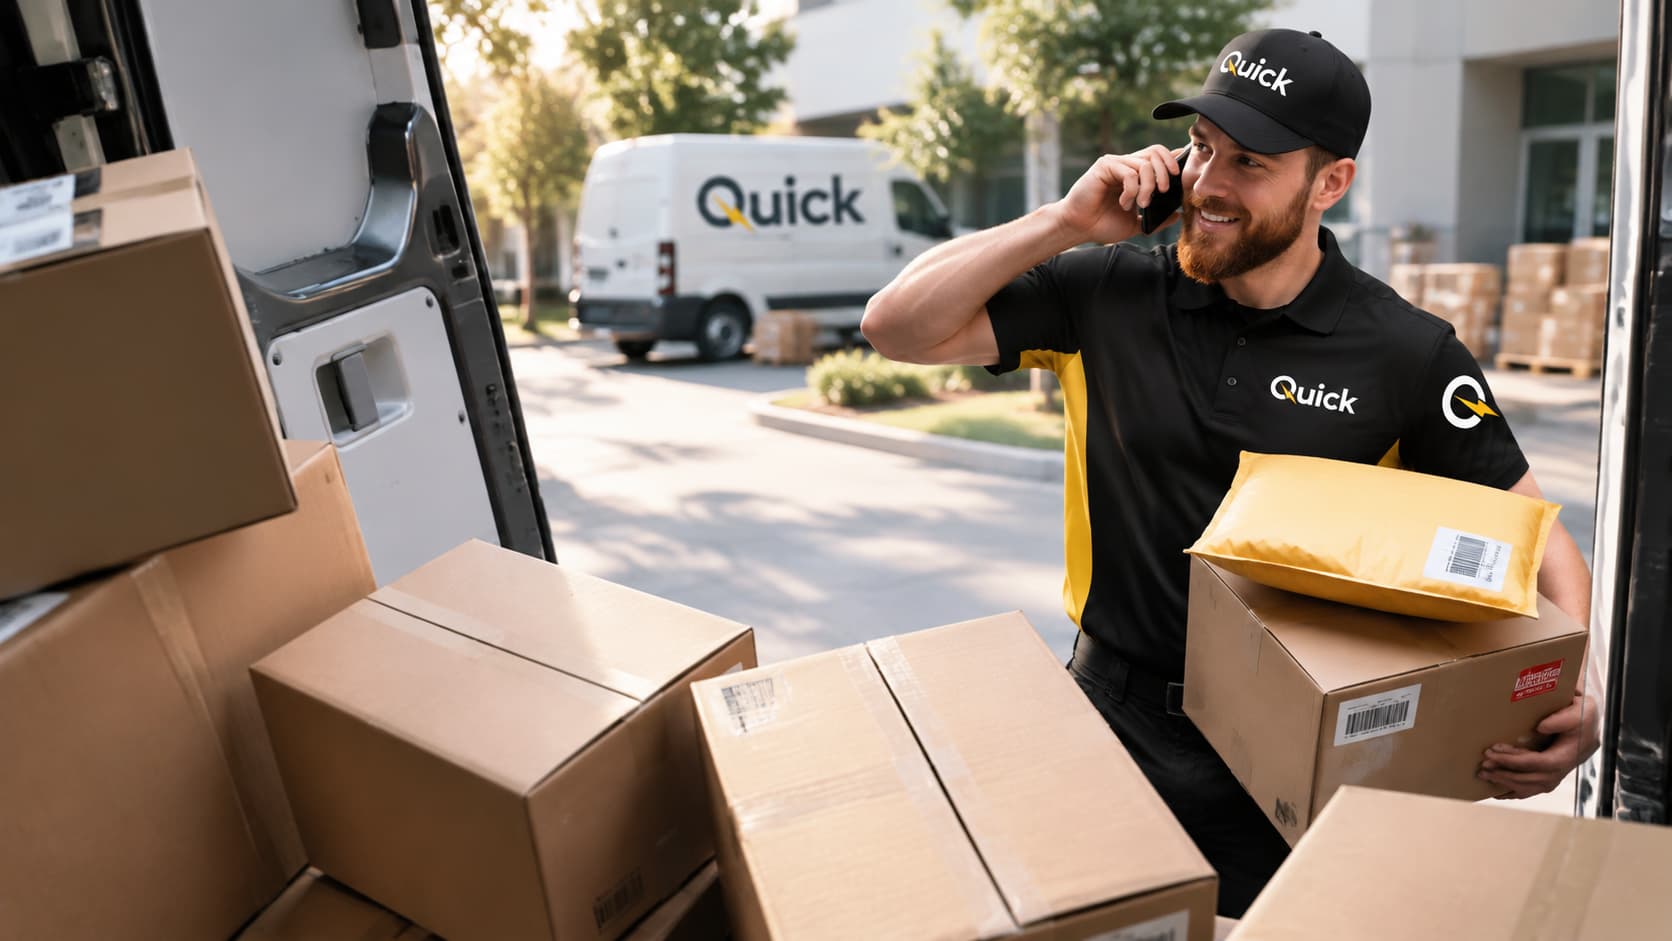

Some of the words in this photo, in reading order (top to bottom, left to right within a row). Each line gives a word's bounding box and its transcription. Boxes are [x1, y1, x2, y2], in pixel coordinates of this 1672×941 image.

[1220, 51, 1294, 96] Quick
[697, 175, 865, 232] Quick
[1270, 375, 1358, 414] Quick
